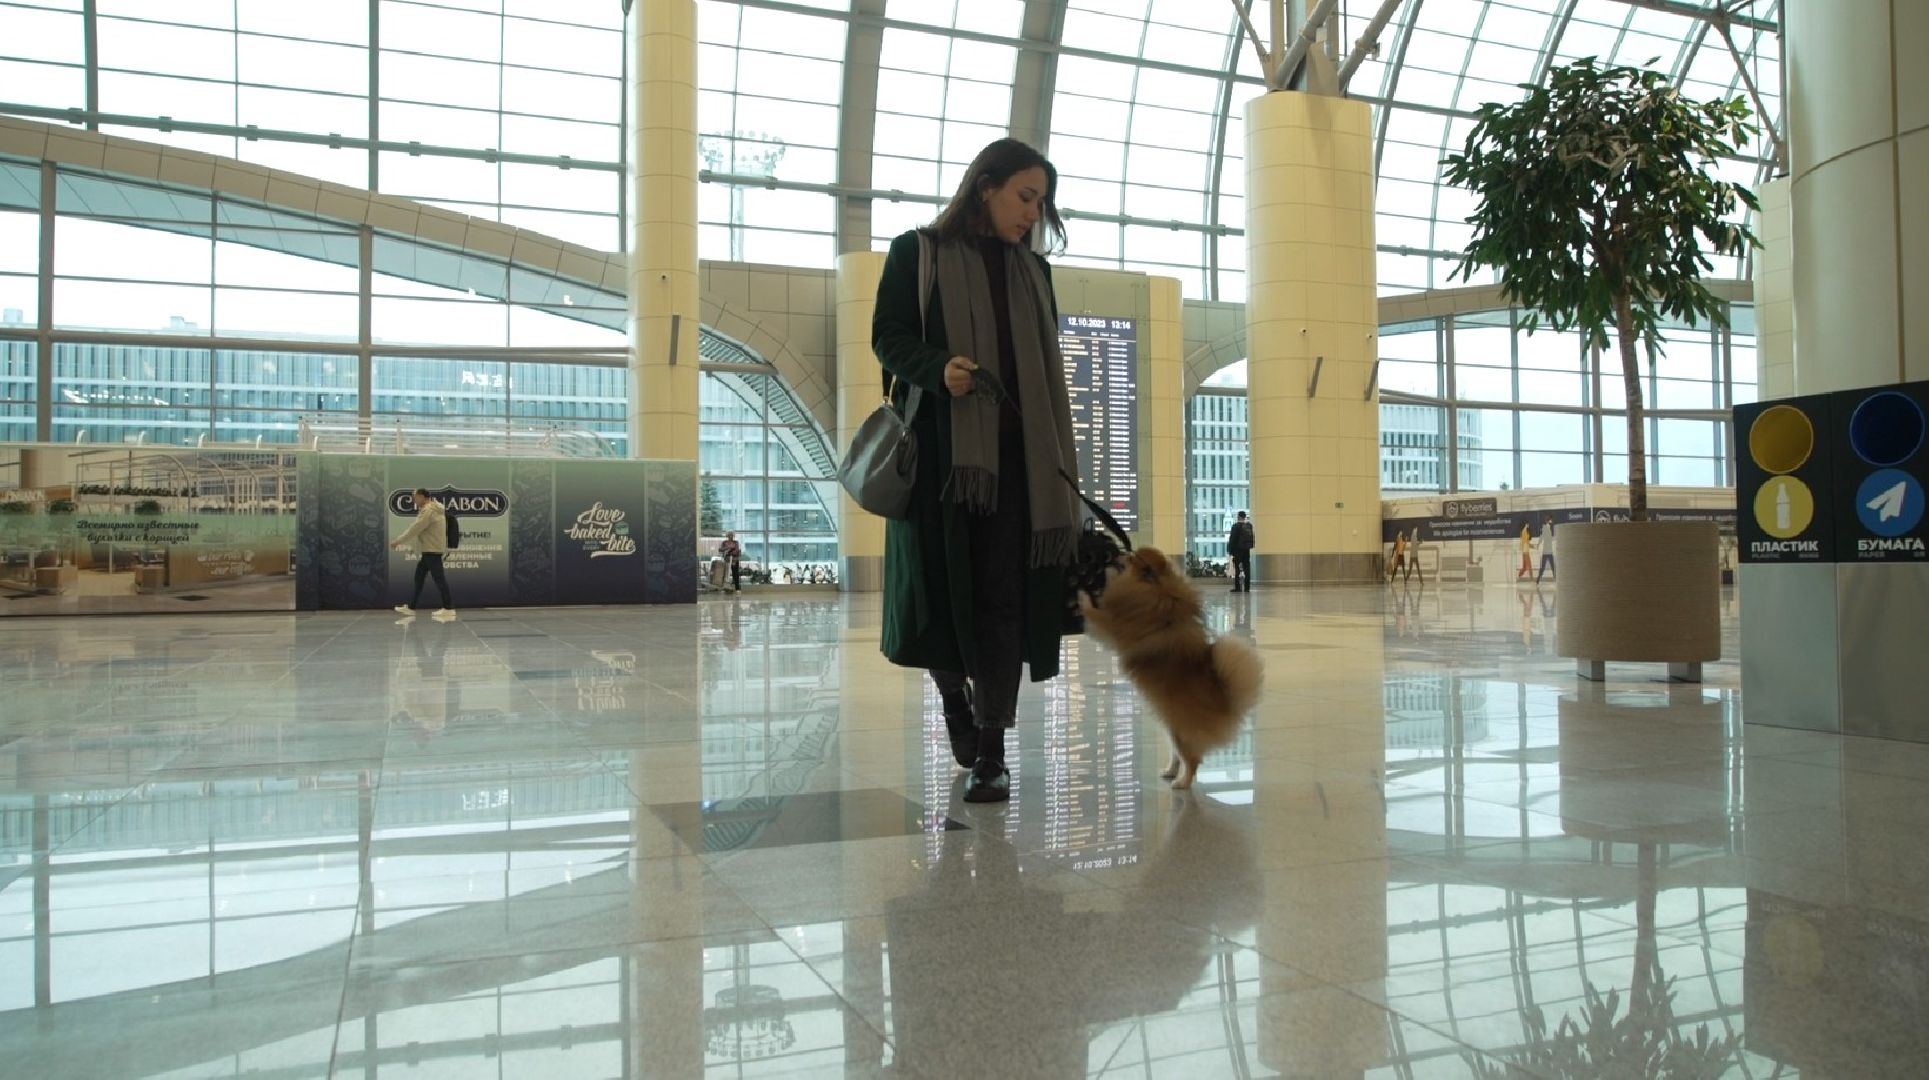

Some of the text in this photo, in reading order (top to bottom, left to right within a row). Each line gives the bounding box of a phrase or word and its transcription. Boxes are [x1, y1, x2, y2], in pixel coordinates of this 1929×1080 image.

[397, 495, 499, 512] CINABON
[577, 501, 625, 525] Love
[77, 520, 199, 531] Всемирно известные
[564, 523, 613, 539] baked
[143, 533, 190, 544] корицей
[1857, 538, 1926, 551] БУМАГА
[591, 534, 636, 558] bite
[1751, 541, 1819, 552] ПЛАСТИК
[443, 561, 480, 569] ОБСТВА
